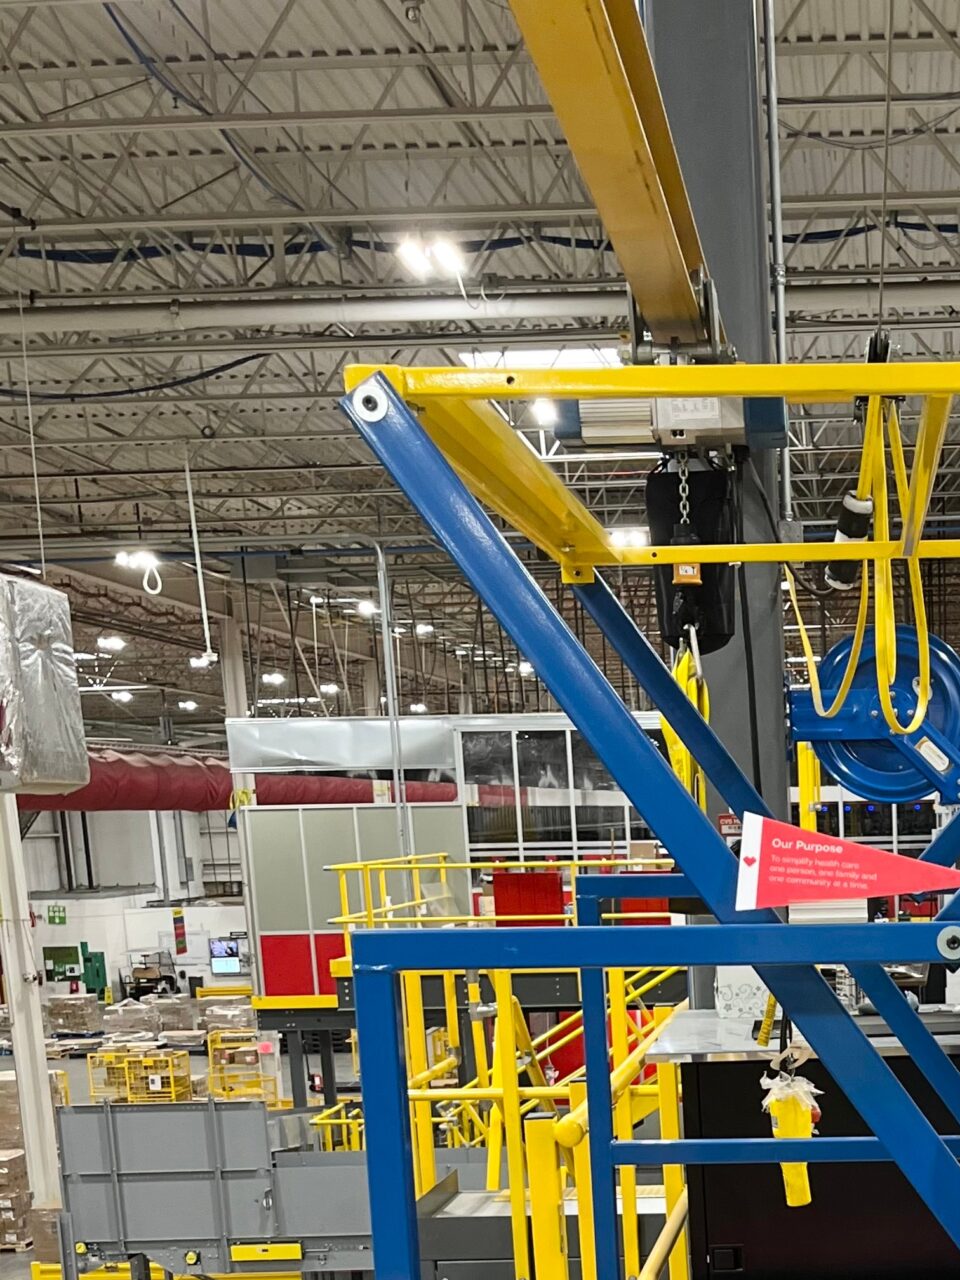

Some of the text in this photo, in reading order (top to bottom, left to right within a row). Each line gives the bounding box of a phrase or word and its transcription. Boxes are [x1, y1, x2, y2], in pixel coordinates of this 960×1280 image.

[771, 838, 844, 854] Our Purpose
[771, 854, 780, 862] To
[815, 858, 840, 868] health
[769, 865, 785, 873] one
[818, 869, 834, 877] one
[835, 869, 860, 880] family
[861, 872, 878, 881] and
[768, 875, 784, 883] one
[785, 876, 831, 888] community
